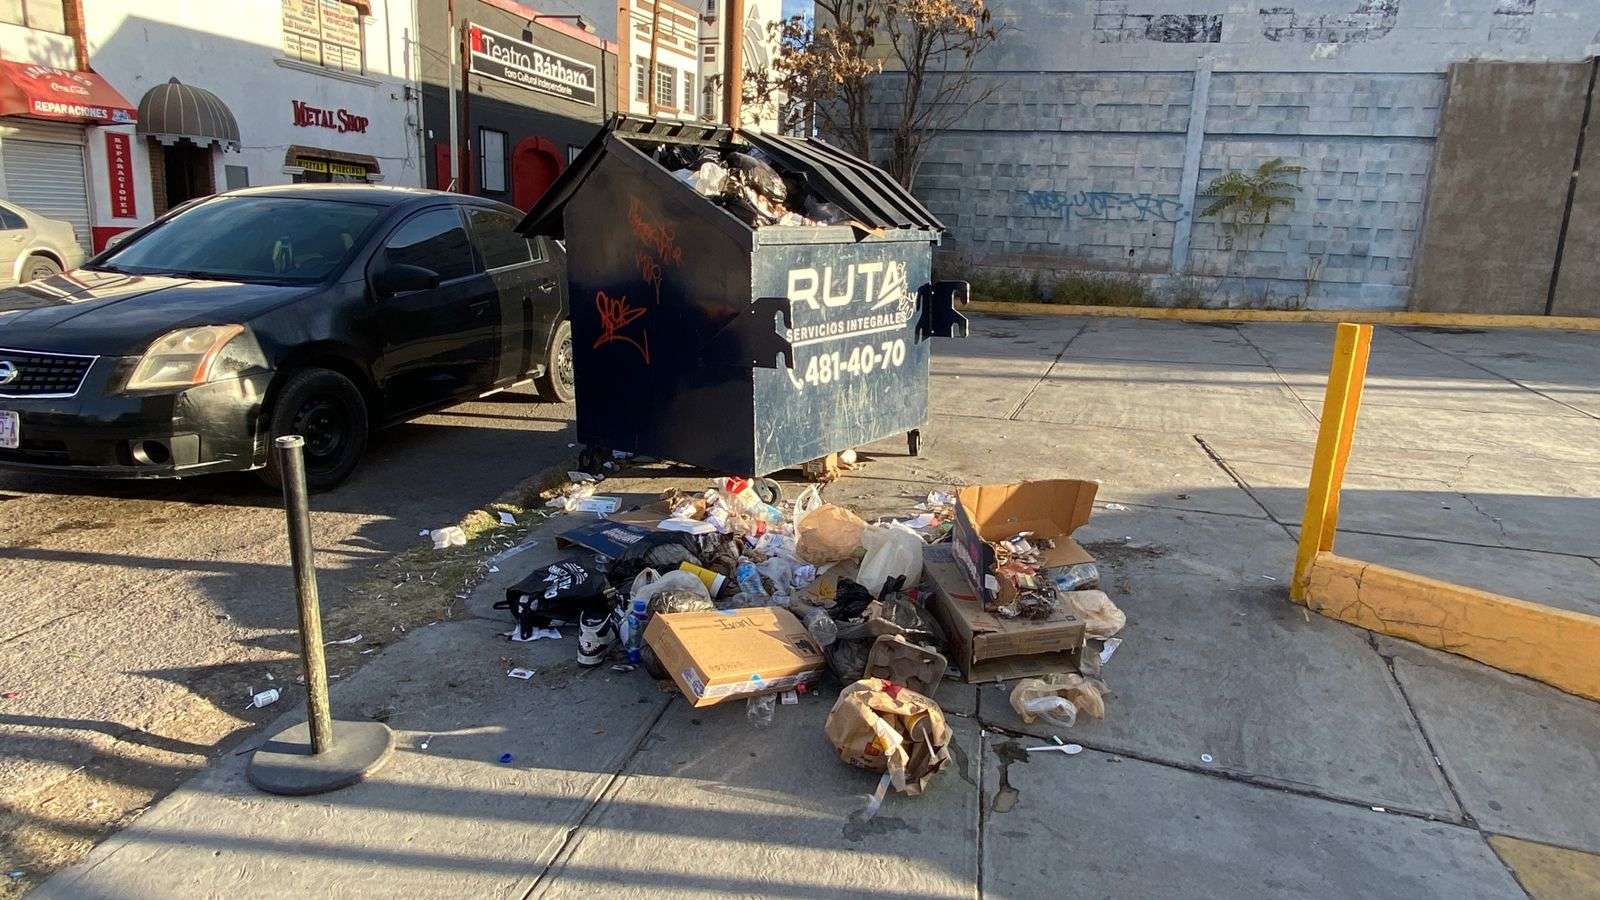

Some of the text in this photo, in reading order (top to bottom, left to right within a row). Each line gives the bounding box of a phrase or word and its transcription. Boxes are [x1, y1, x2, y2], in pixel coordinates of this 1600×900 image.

[482, 34, 588, 88] Teatro Bárbaro
[504, 67, 573, 96] Foro Cultural Independiente
[34, 100, 108, 119] REPARACIONES
[292, 100, 369, 134] METAL SHOP
[114, 137, 128, 214] REPARACIONES
[787, 260, 902, 311] RUTA
[786, 311, 907, 341] SERVICIOS INTEGRALES
[804, 338, 906, 386] 481-40-70
